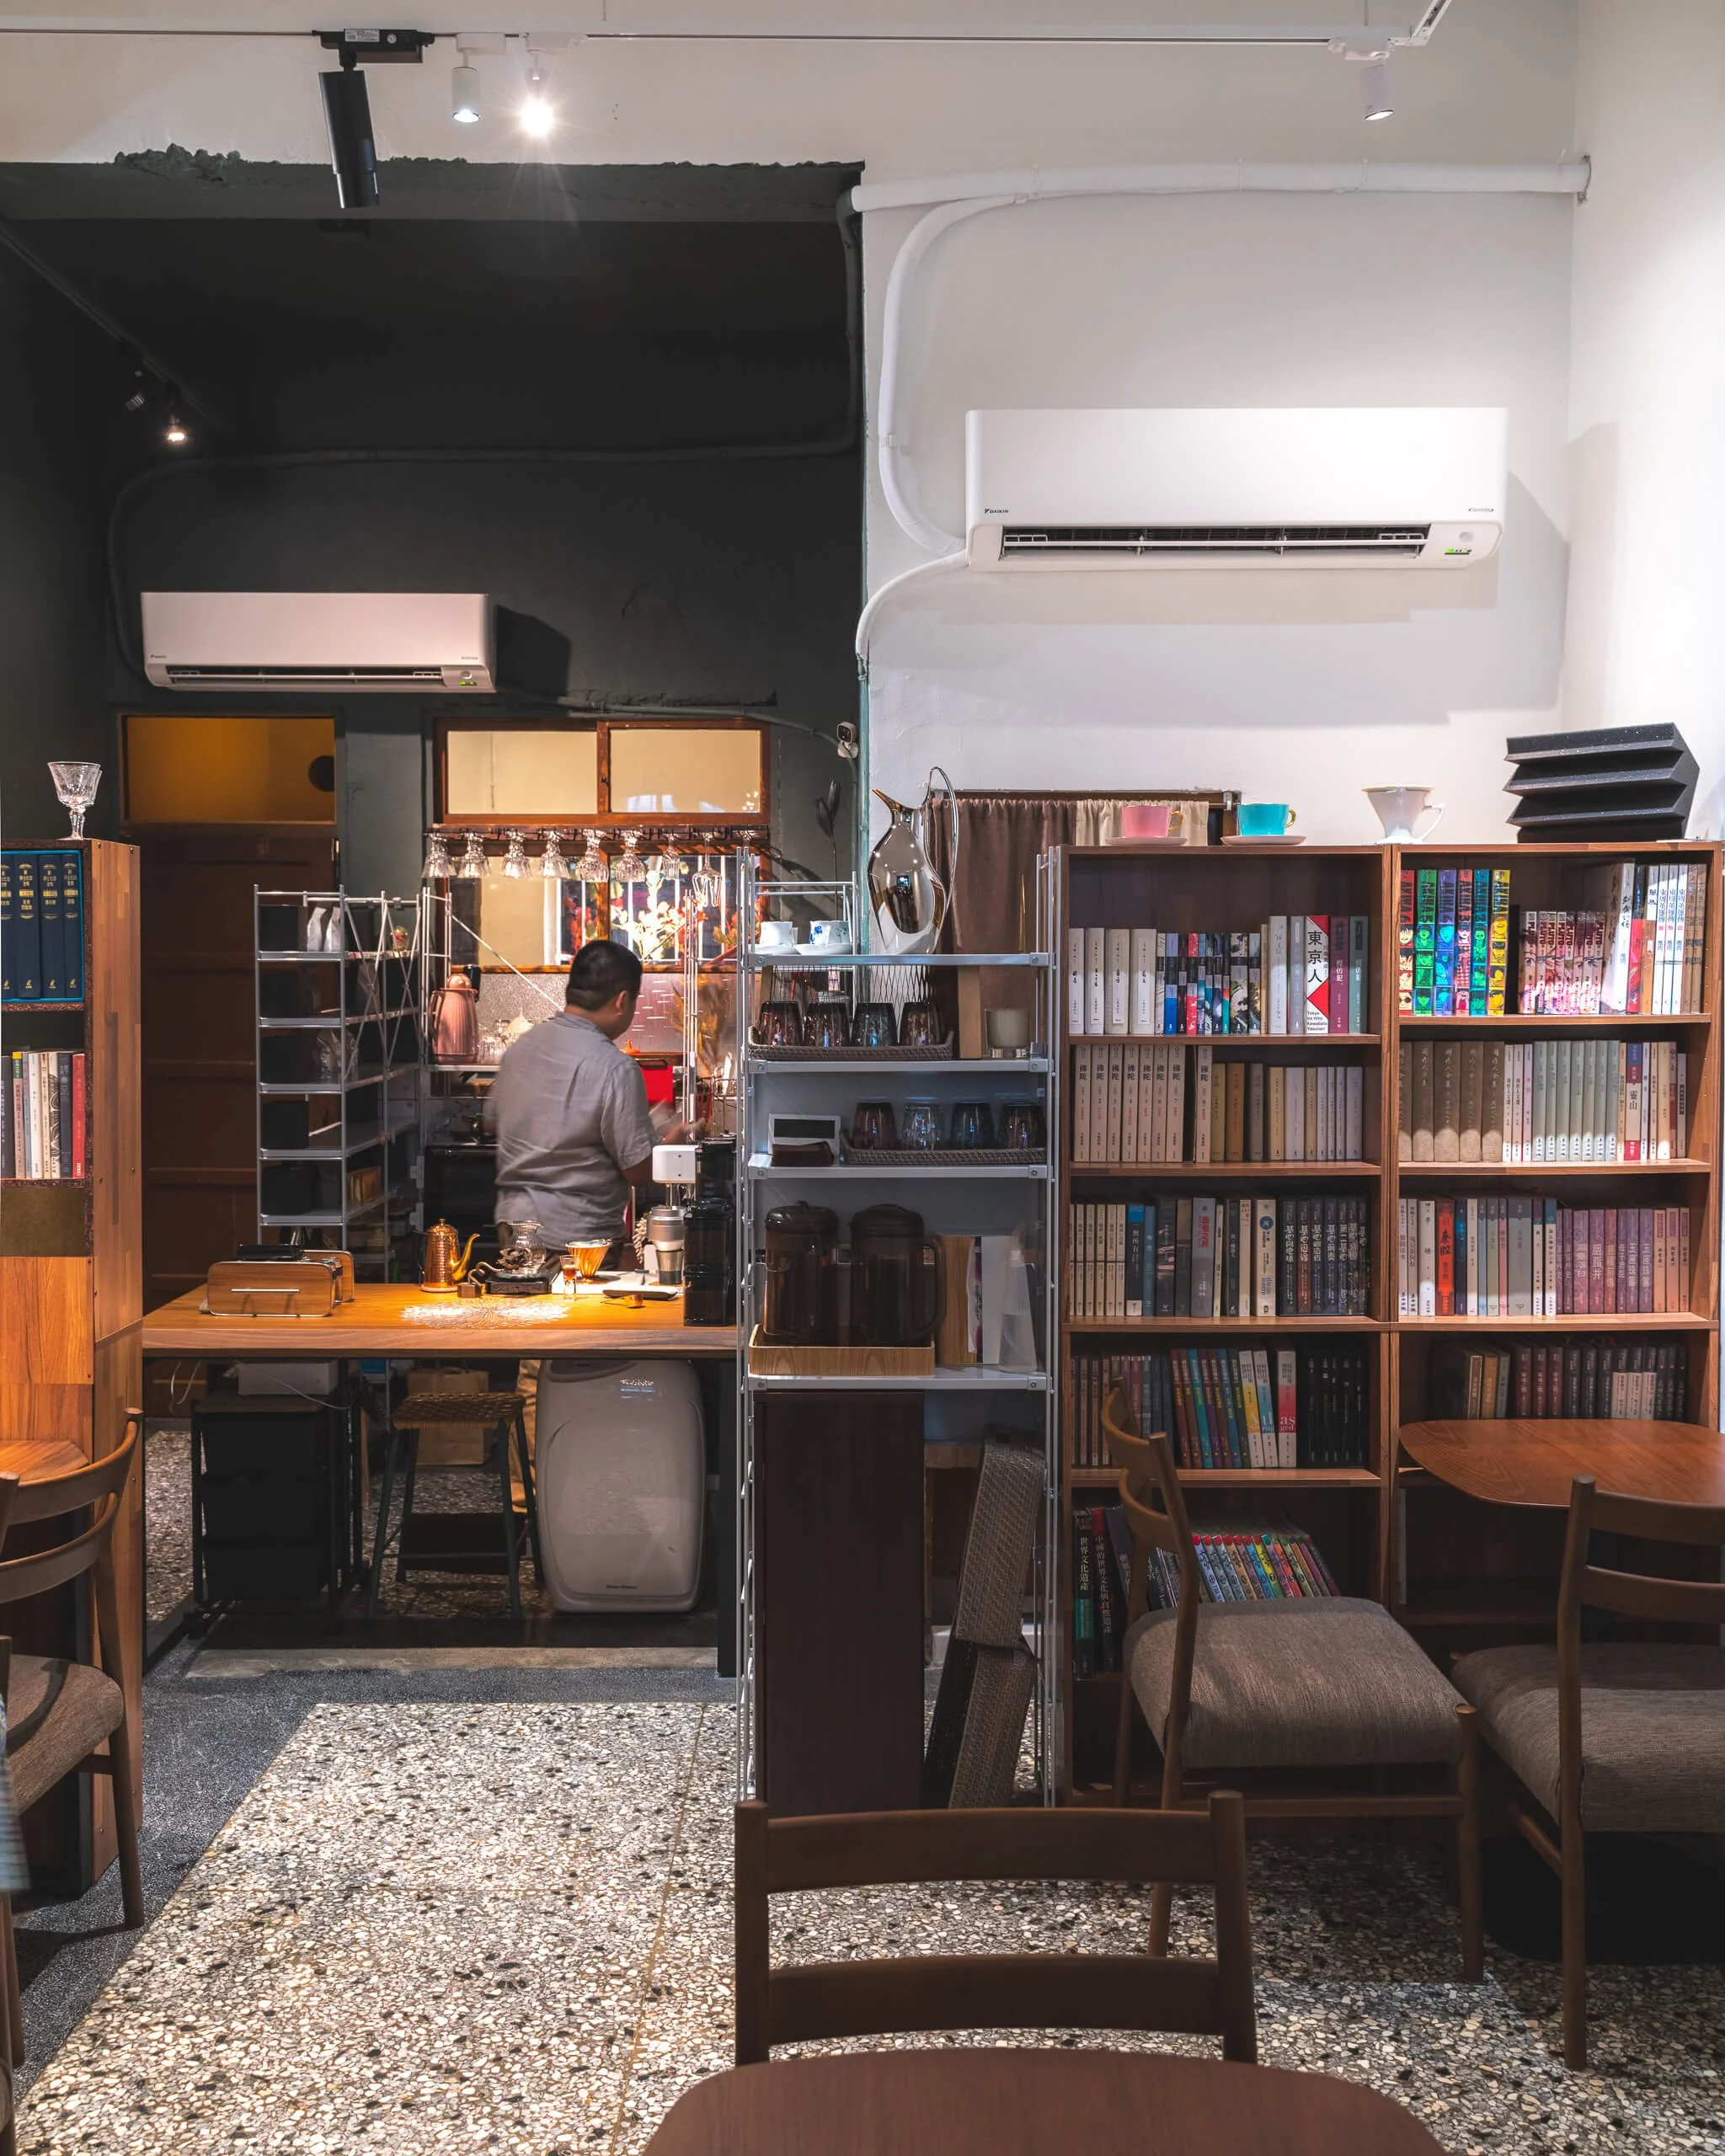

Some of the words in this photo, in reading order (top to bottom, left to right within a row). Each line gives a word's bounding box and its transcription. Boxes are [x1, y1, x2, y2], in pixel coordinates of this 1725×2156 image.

[1307, 930, 1322, 983] 東京人
[1630, 1090, 1637, 1111] 靈山
